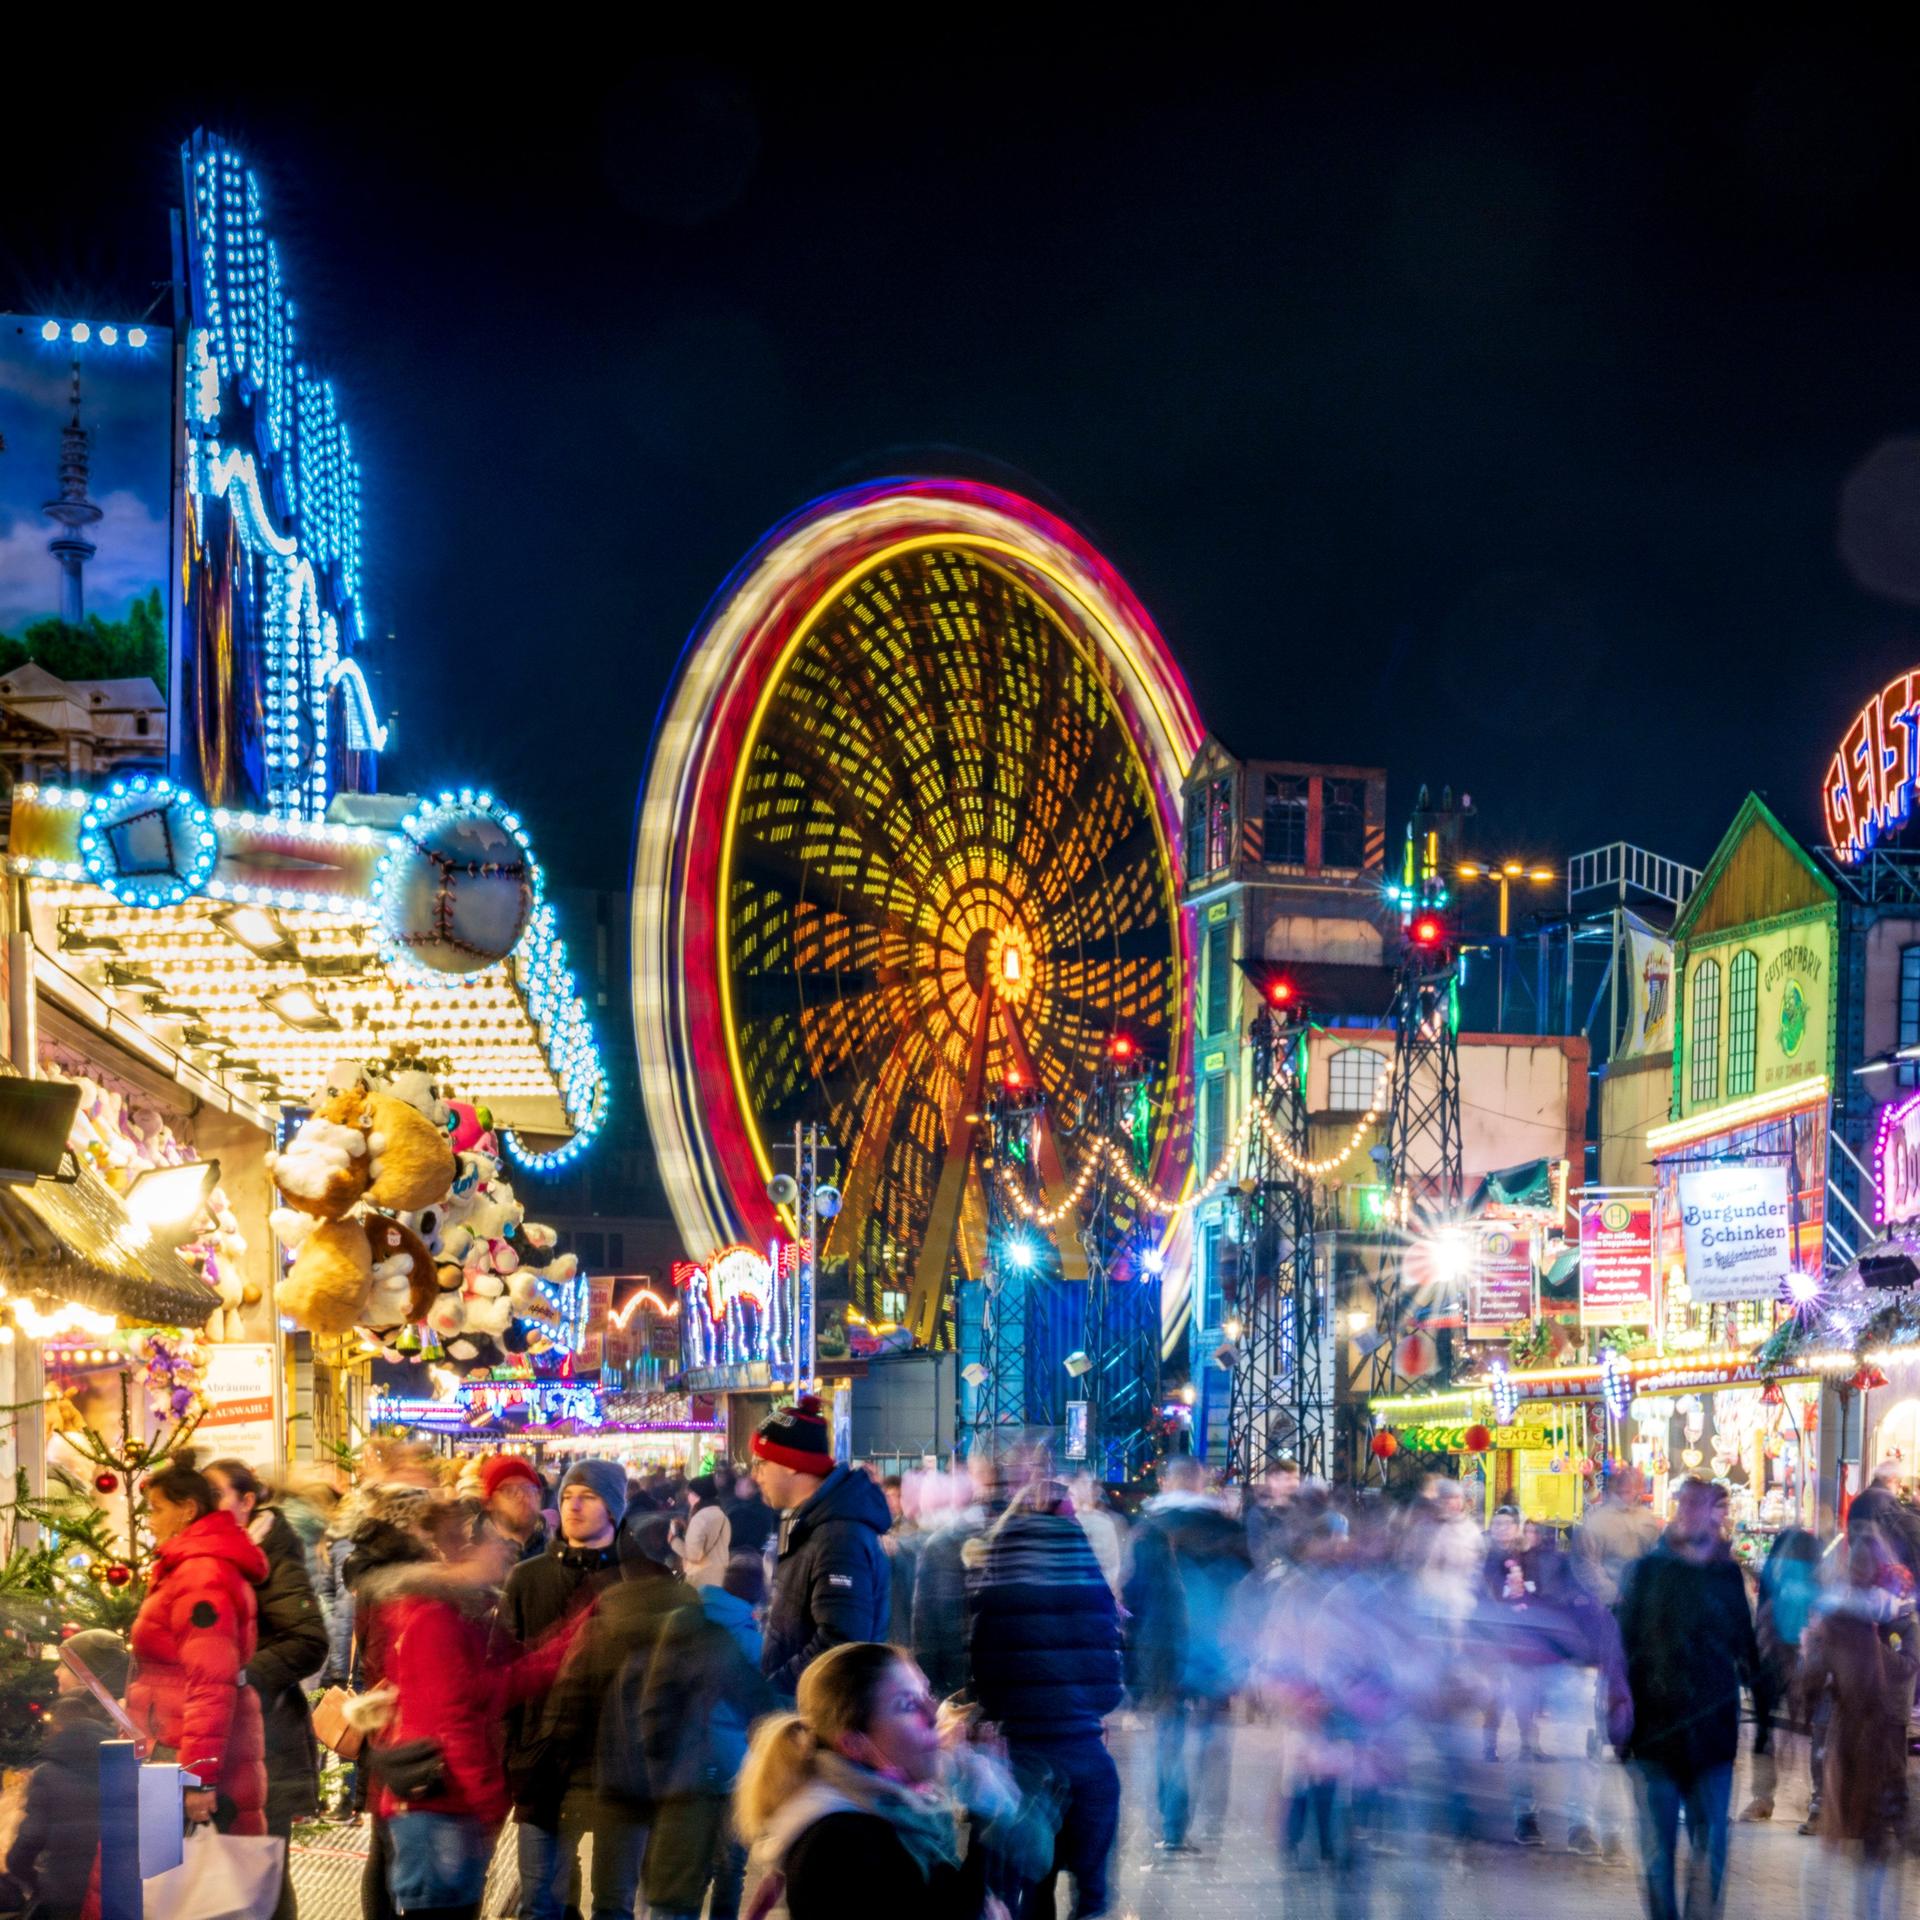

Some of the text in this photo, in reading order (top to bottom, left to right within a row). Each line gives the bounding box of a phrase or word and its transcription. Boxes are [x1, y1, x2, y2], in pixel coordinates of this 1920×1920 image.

[1764, 945, 1822, 993] GEISTERFABRIK
[1684, 1201, 1787, 1226] Burgunder
[1700, 1224, 1786, 1247] Schinken
[215, 1403, 269, 1417] AUSWAHL!
